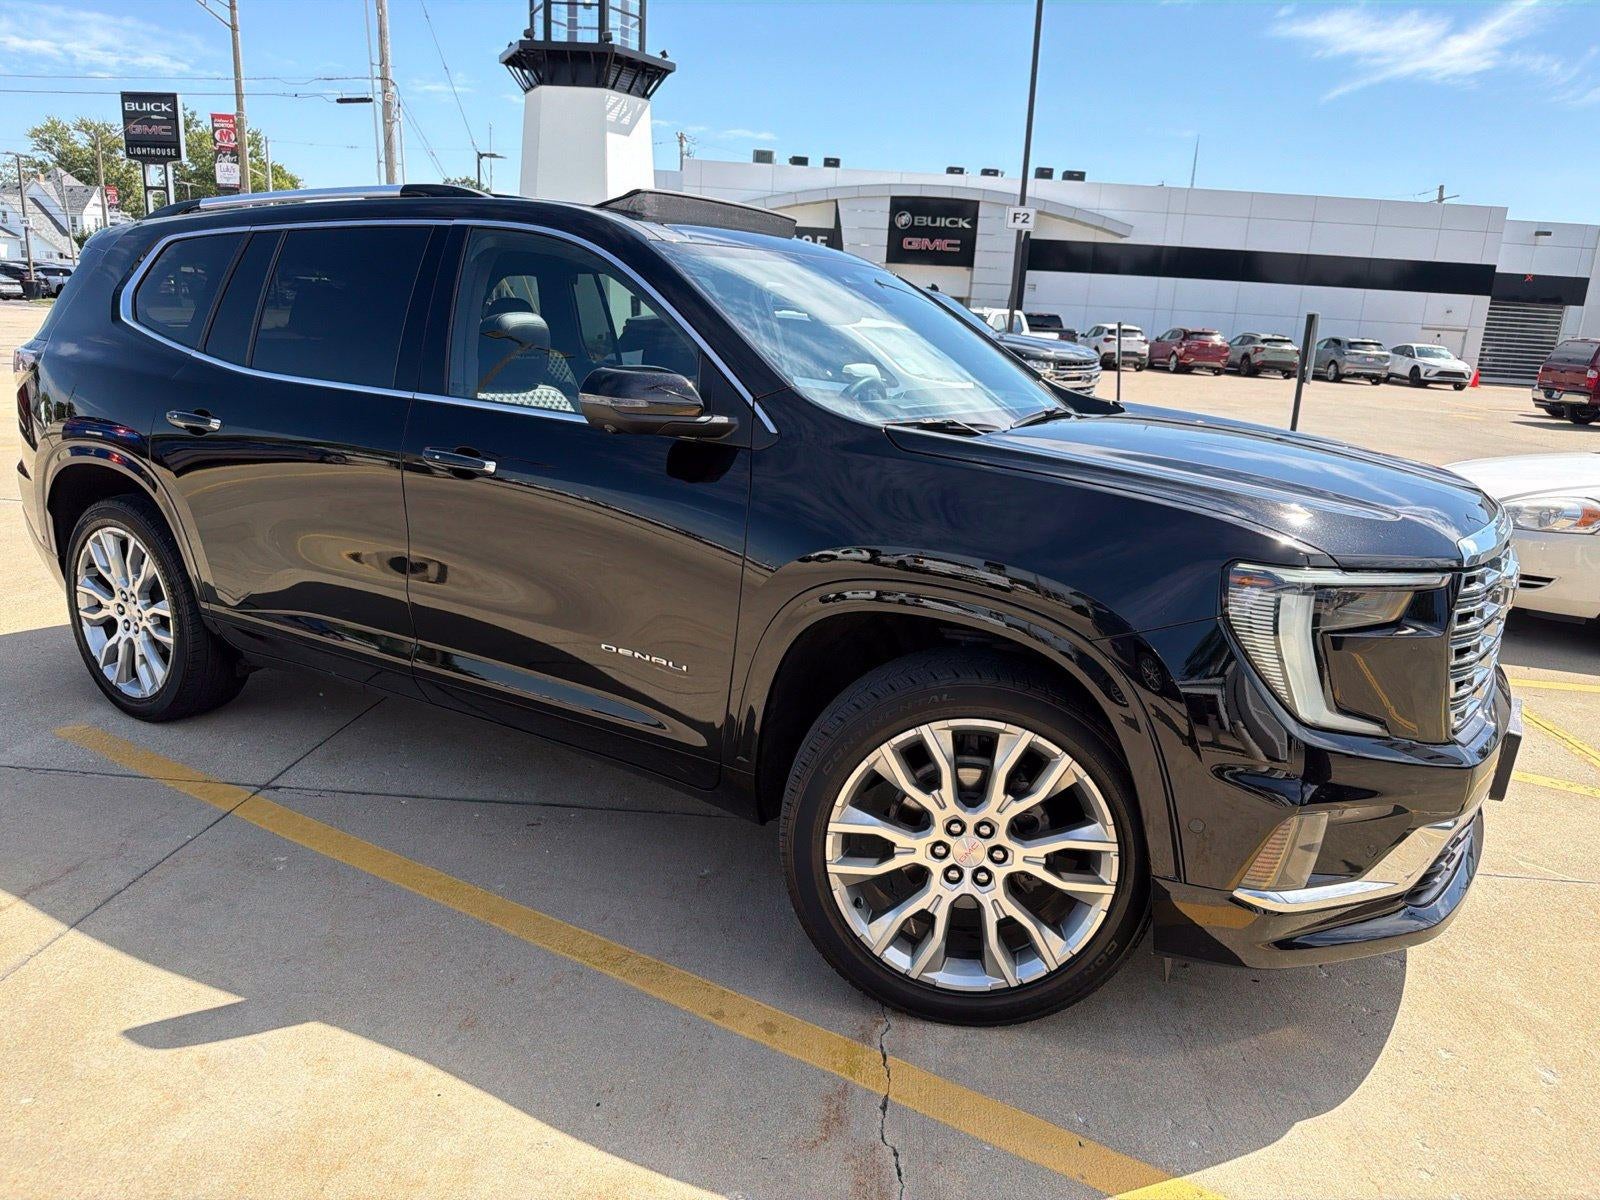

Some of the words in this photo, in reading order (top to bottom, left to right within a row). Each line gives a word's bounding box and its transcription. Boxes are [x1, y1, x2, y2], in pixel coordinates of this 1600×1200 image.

[124, 101, 173, 112] BUICK
[128, 124, 172, 136] GMC
[129, 147, 176, 156] LIGHTHOUSE
[913, 215, 972, 229] BUICK
[1012, 212, 1030, 225] F2
[902, 237, 961, 251] GMC
[600, 643, 688, 673] DENALI
[958, 841, 980, 863] GMC
